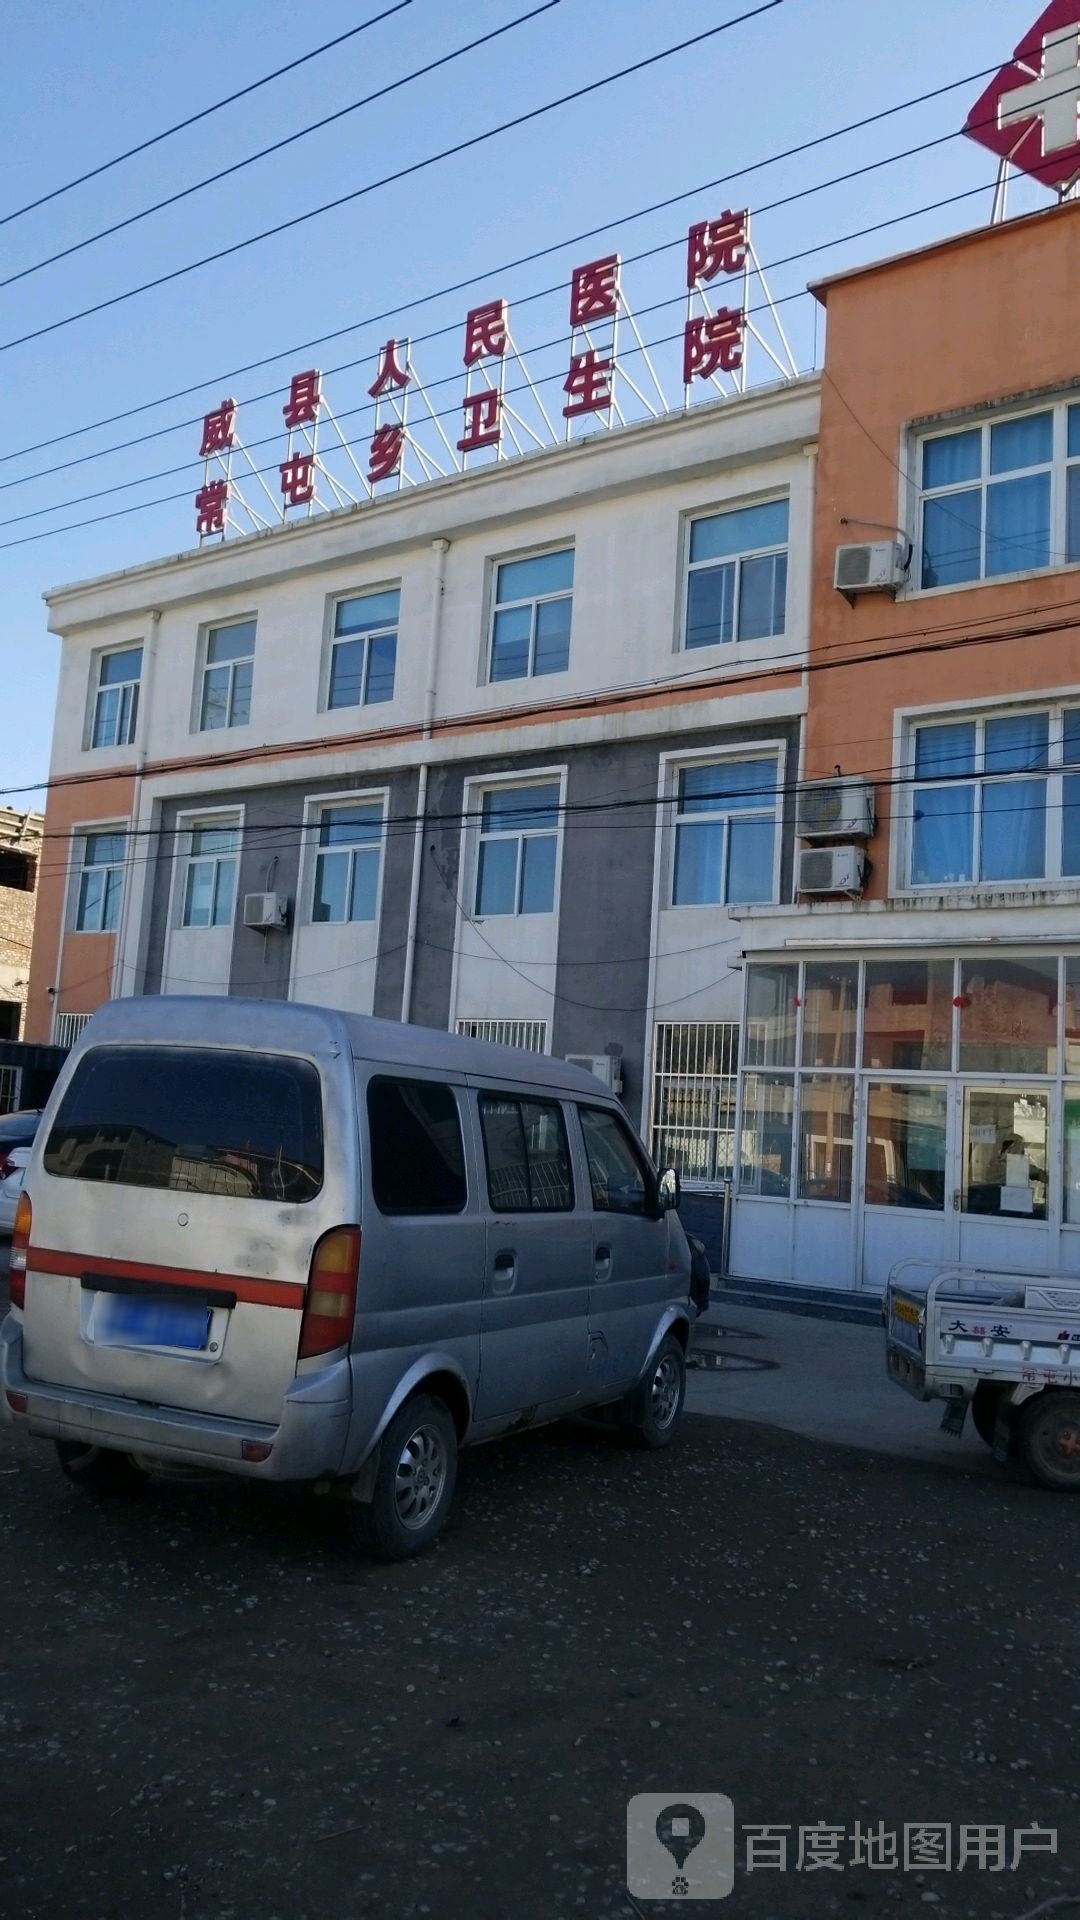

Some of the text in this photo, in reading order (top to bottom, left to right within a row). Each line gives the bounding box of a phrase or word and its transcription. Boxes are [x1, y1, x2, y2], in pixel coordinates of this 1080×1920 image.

[195, 306, 744, 534] 常屯乡卫生院
[199, 208, 749, 457] 威县人民医院
